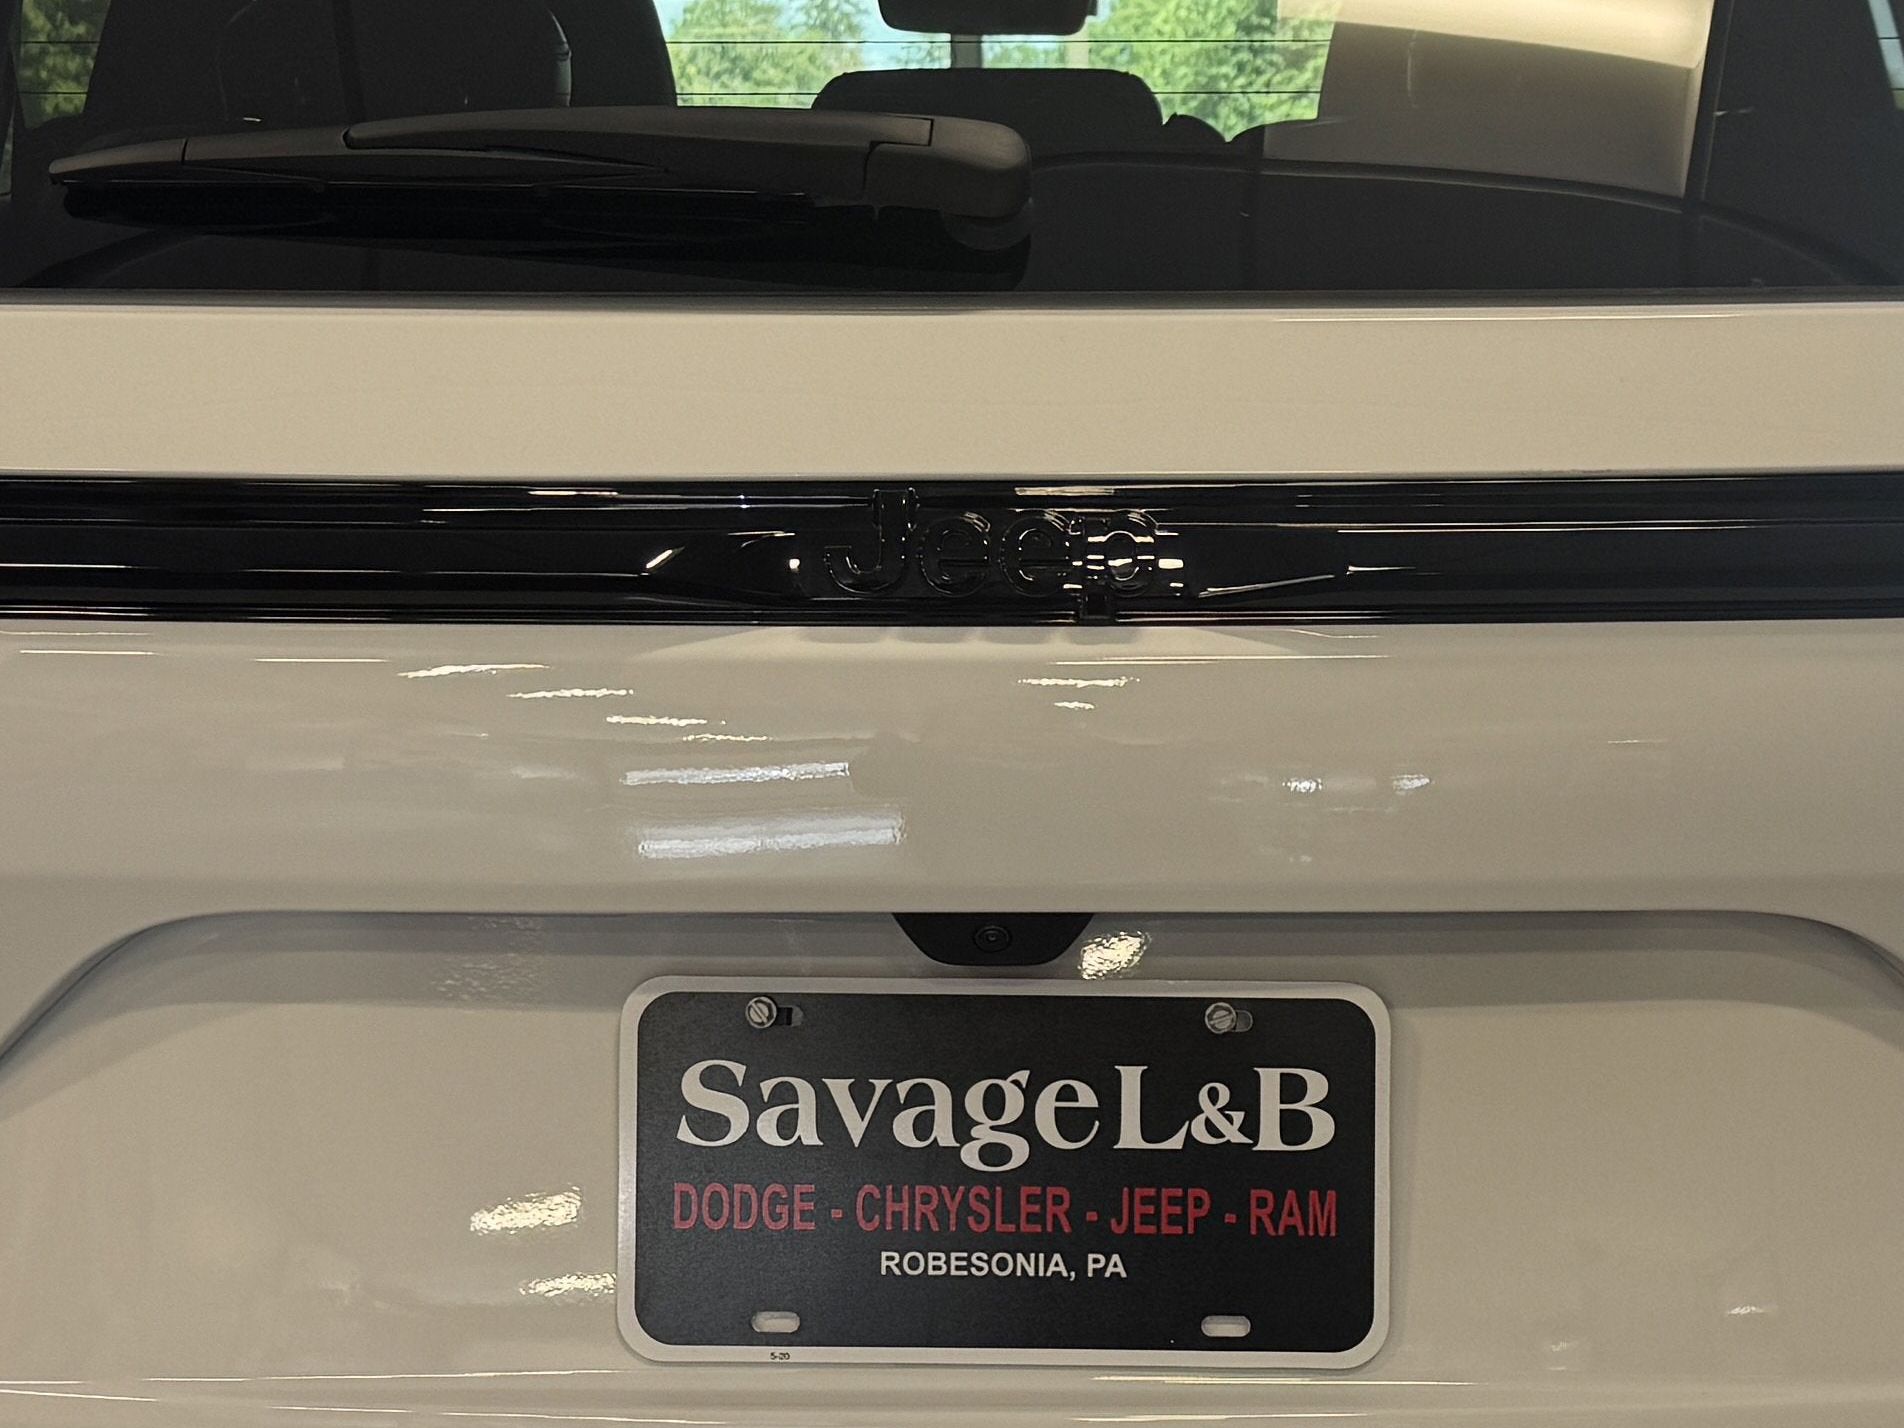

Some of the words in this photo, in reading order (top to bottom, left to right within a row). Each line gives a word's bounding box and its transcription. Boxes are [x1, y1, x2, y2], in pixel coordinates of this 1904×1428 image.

[823, 487, 1158, 619] Jeep
[673, 1183, 815, 1231] DODGE
[855, 1185, 1072, 1235] CHRYSLER
[1110, 1187, 1211, 1236] JEEP
[1249, 1189, 1338, 1237] RAM
[880, 1251, 1076, 1281] ROBESONIA,
[1087, 1253, 1127, 1278] PA
